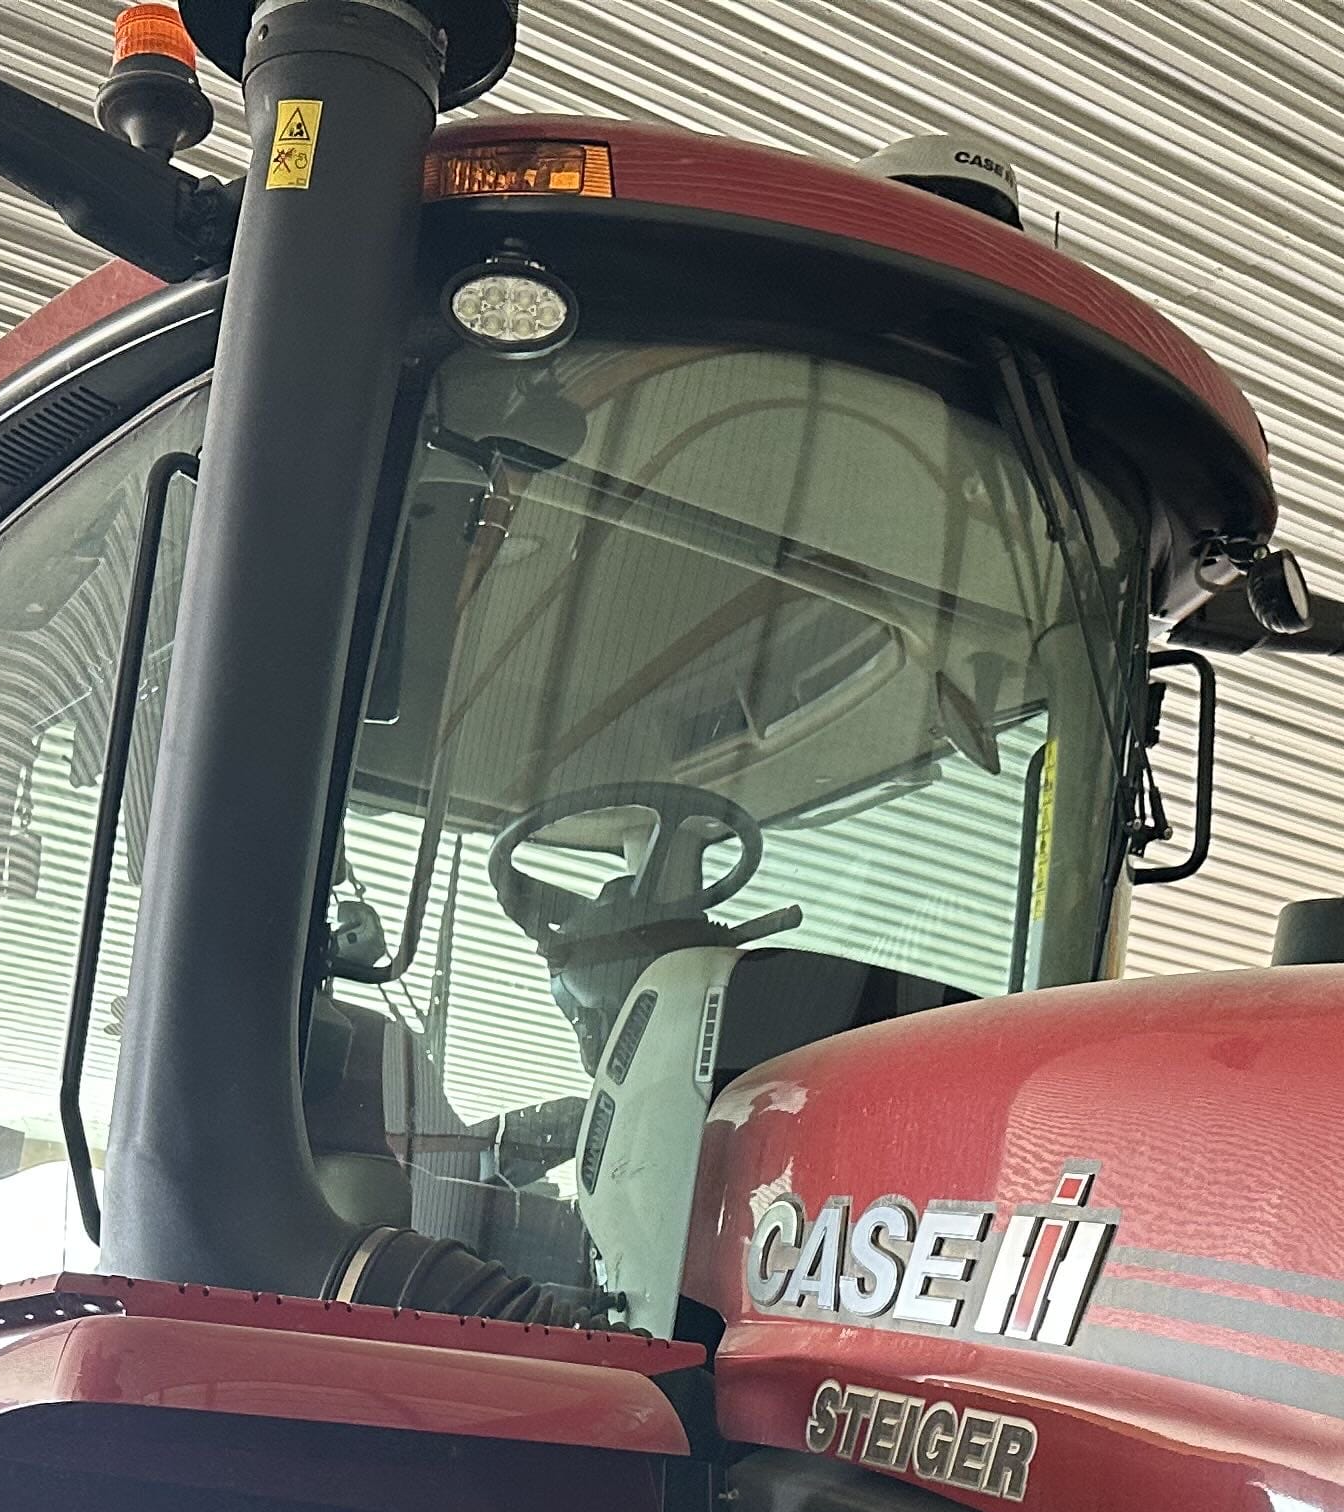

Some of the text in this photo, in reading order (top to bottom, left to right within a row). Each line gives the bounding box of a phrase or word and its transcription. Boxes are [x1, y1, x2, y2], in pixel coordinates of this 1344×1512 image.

[954, 151, 1004, 177] CASE
[748, 1200, 994, 1326] CASE
[805, 1380, 1038, 1502] STEIGER
